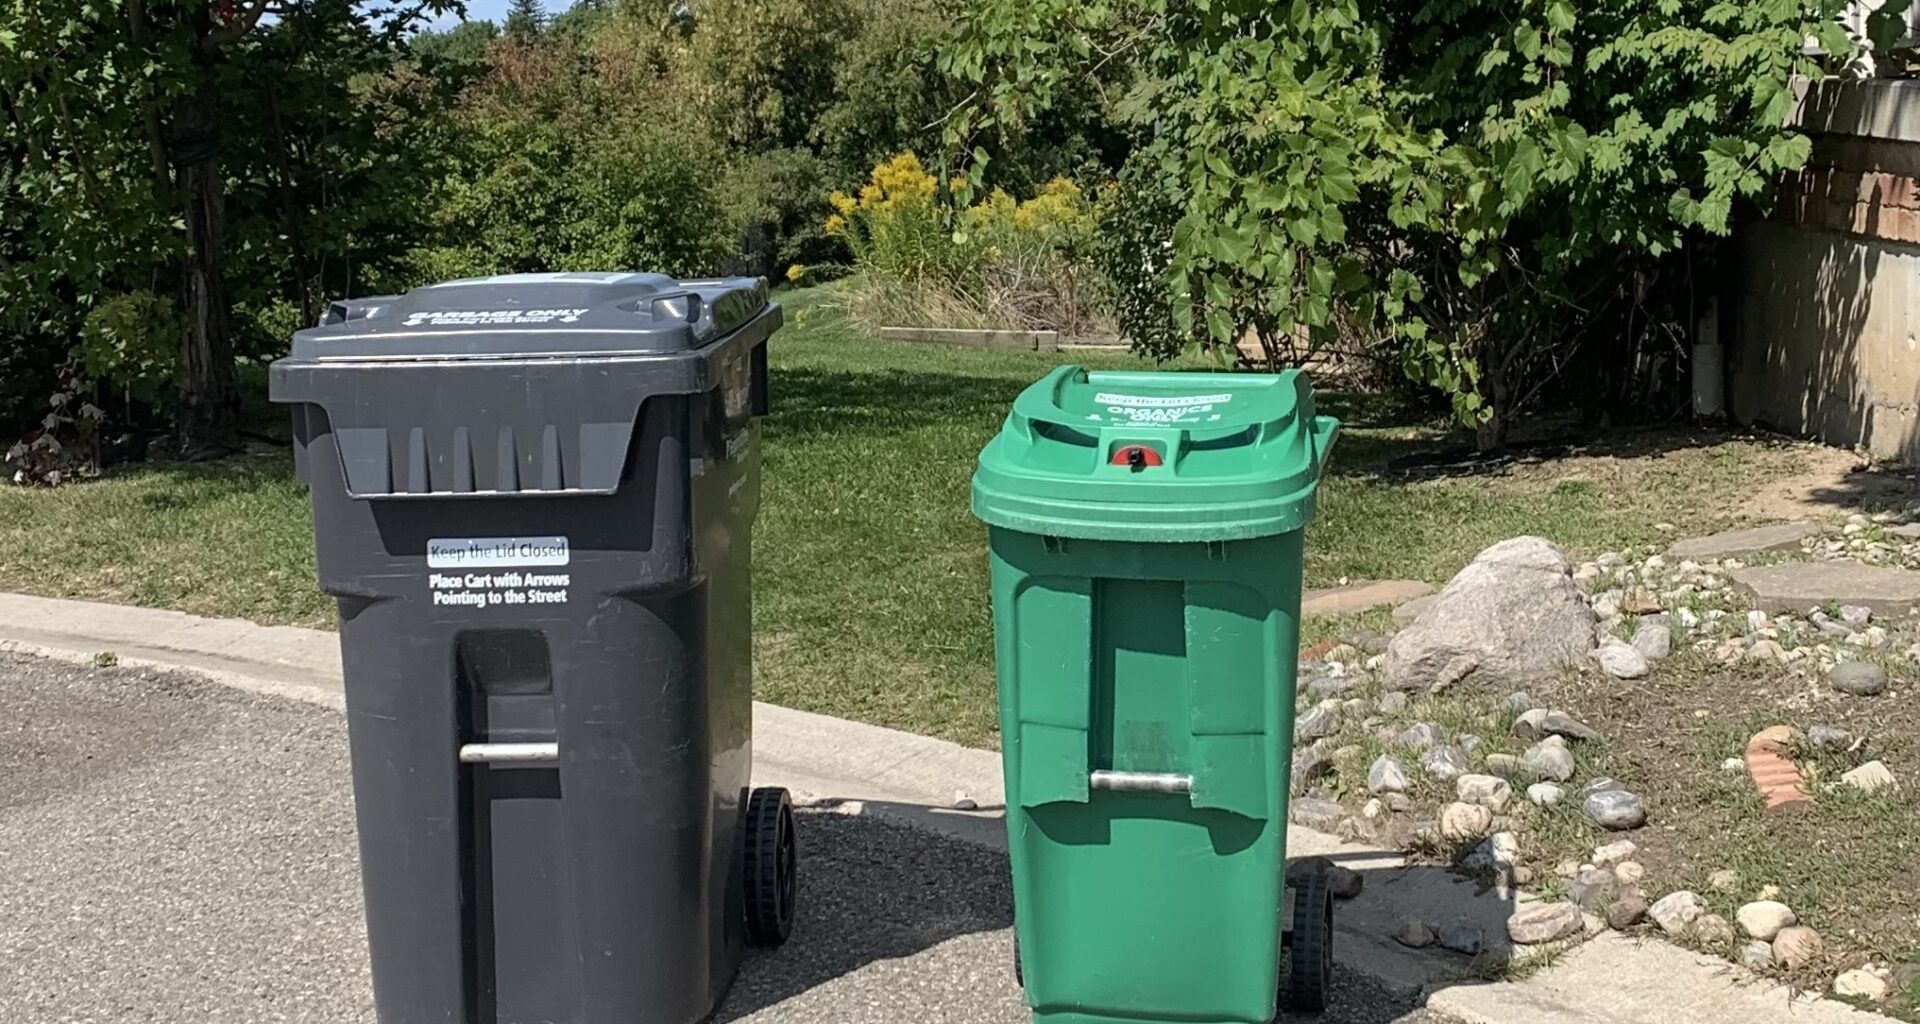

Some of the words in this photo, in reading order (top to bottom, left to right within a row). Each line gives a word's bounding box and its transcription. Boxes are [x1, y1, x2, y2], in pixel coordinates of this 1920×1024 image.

[408, 310, 523, 319] GARBAGE
[525, 308, 590, 317] ONLY
[1107, 404, 1213, 415] ORGANICS
[431, 545, 466, 562] Keep
[469, 544, 493, 559] the
[495, 543, 516, 558] Lid
[519, 542, 565, 557] Closed
[429, 573, 462, 588] Place
[464, 573, 493, 588] Cart
[493, 571, 523, 587] with
[523, 572, 570, 587] Arrows
[433, 590, 486, 608] Pointing
[487, 590, 502, 604] to
[504, 589, 526, 604] the
[527, 589, 567, 604] Street
